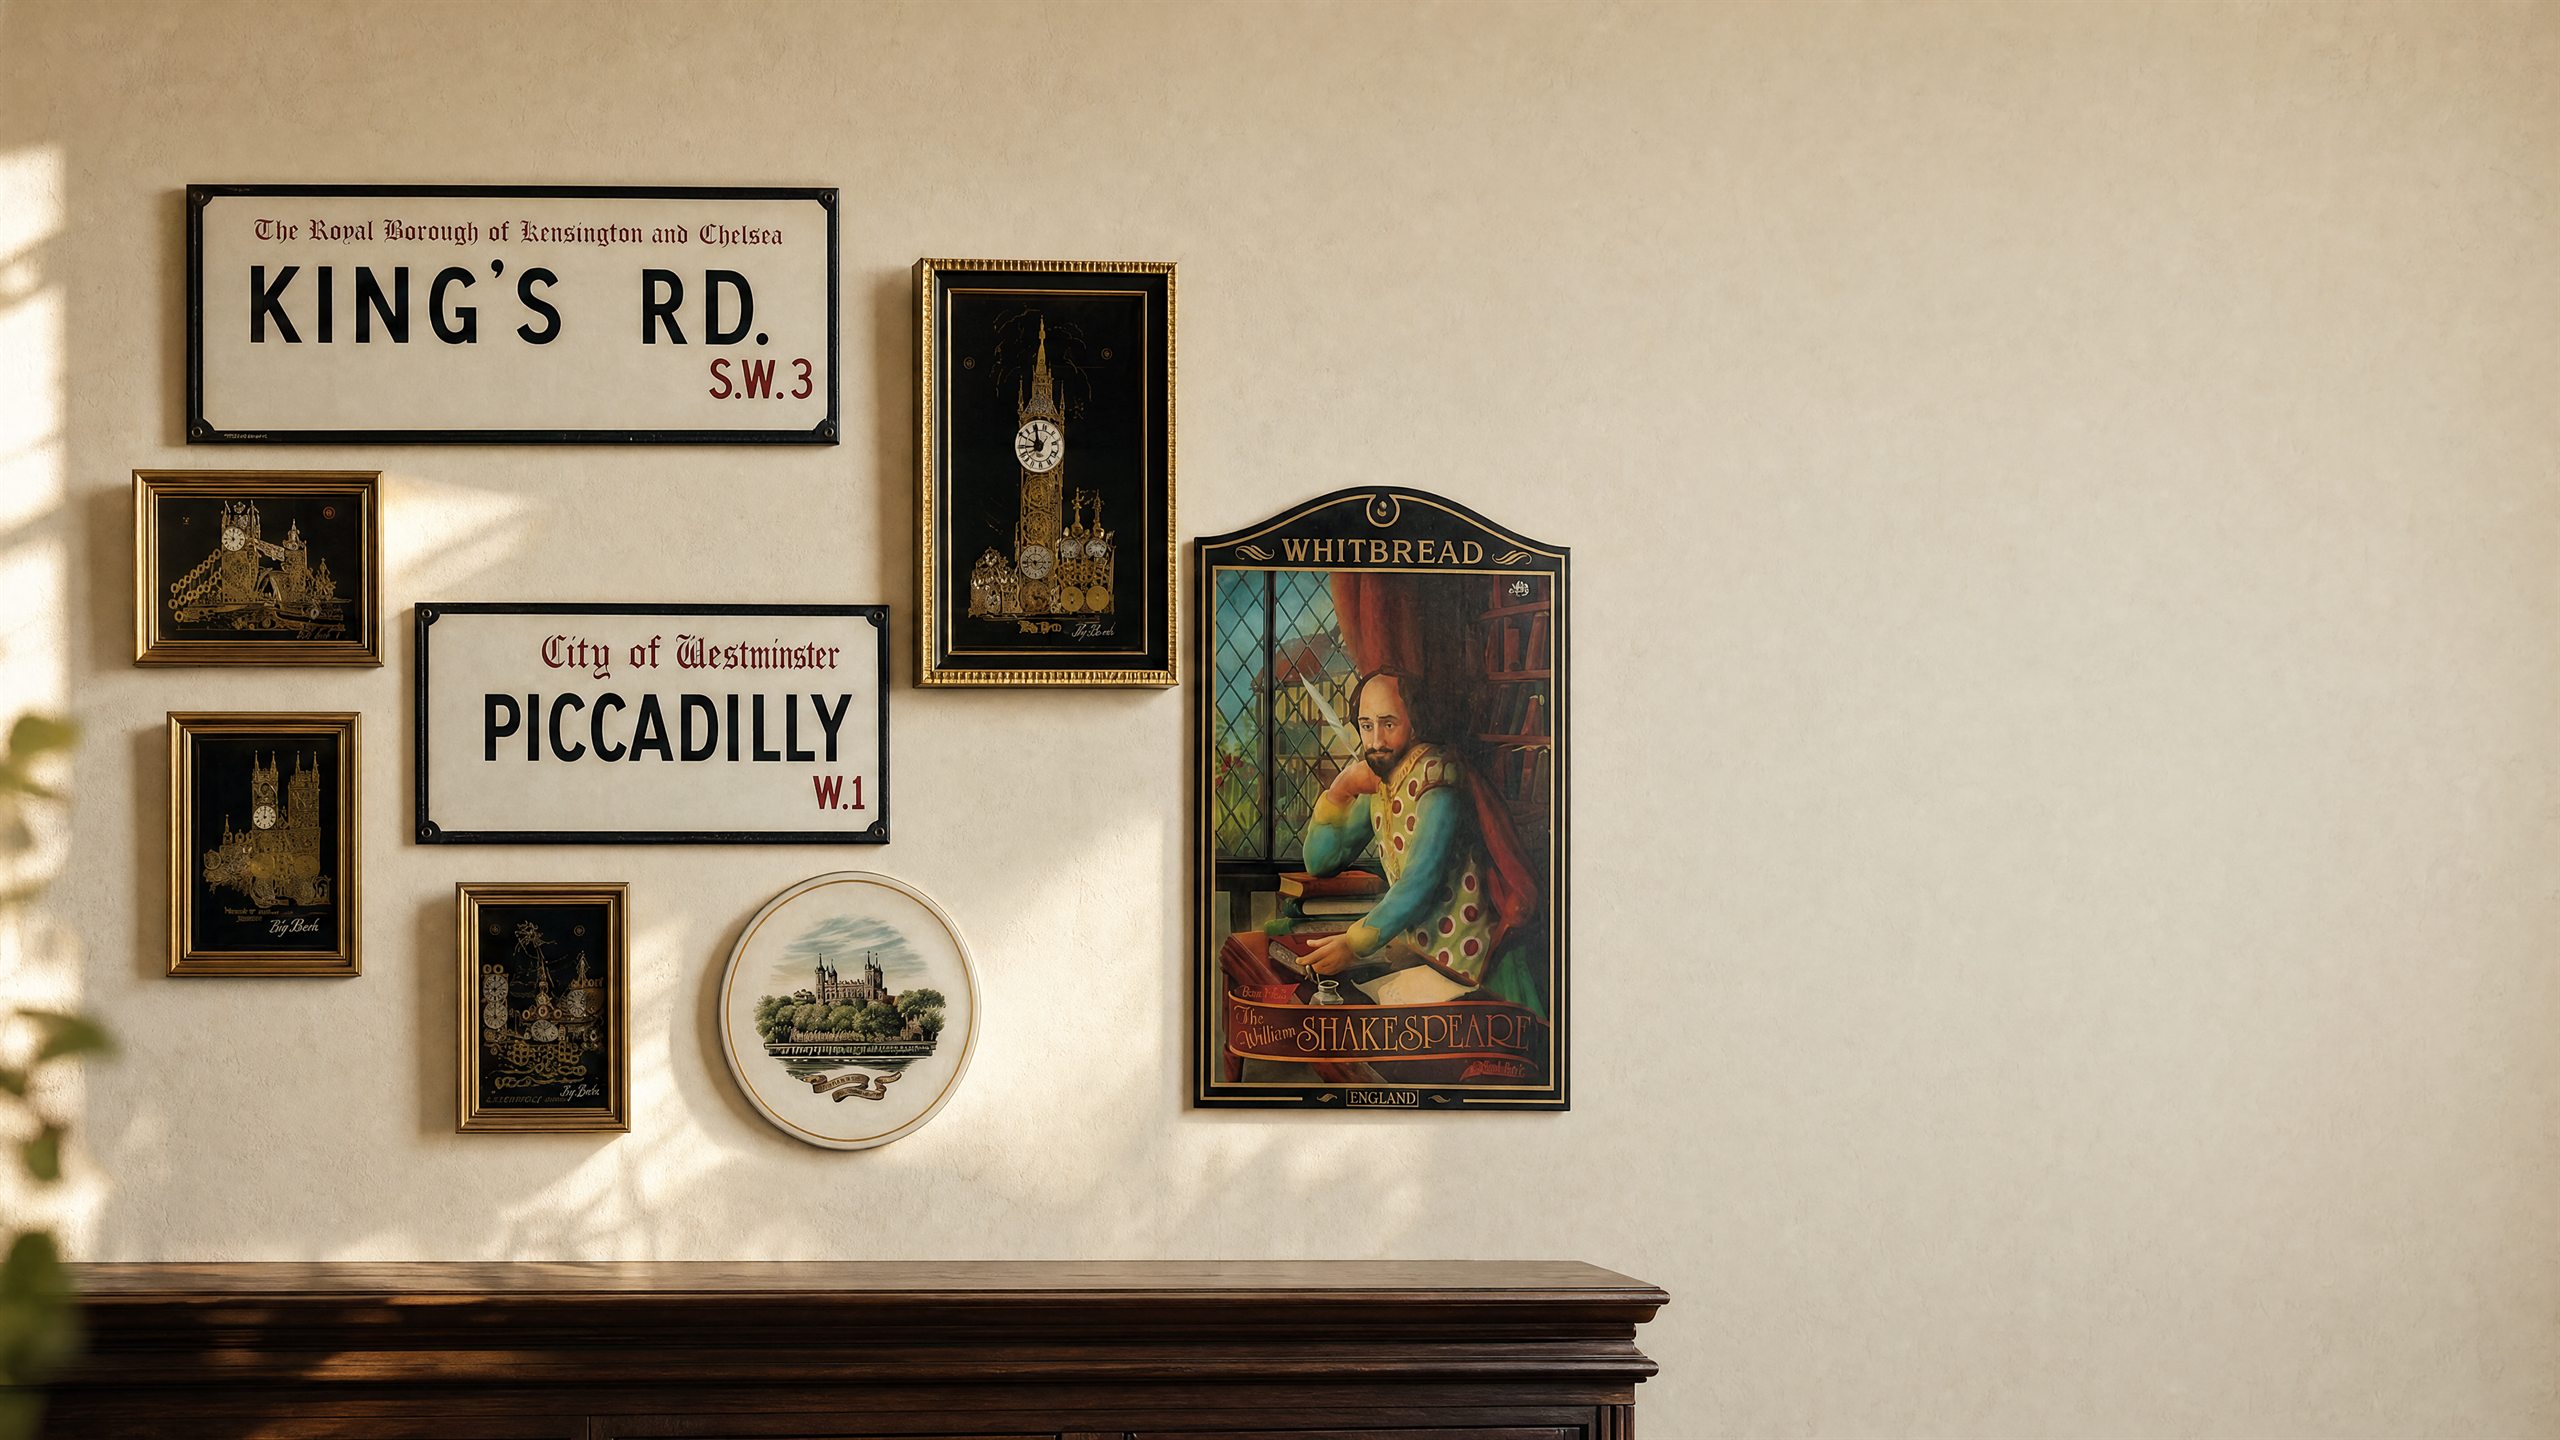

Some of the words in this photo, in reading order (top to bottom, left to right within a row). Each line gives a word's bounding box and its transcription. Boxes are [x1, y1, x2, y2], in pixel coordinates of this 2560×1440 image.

[254, 219, 298, 244] The
[309, 219, 373, 246] Royal
[383, 219, 478, 247] Borough
[488, 220, 510, 242] of
[520, 220, 643, 248] Kensington
[652, 224, 688, 244] and
[699, 223, 783, 248] Chelsea
[250, 258, 562, 345] KING'S
[642, 269, 769, 345] RD.
[1281, 538, 1483, 564] WHITBREAD
[542, 635, 610, 679] City
[629, 634, 662, 670] of
[676, 634, 840, 670] Westminster
[484, 692, 853, 763] PICCADILLY
[813, 776, 866, 810] W.1
[1233, 1005, 1264, 1025] The
[1235, 1025, 1296, 1049] William
[1296, 1013, 1531, 1052] SHAKESPEARE
[1349, 1091, 1416, 1106] ENGLAND
